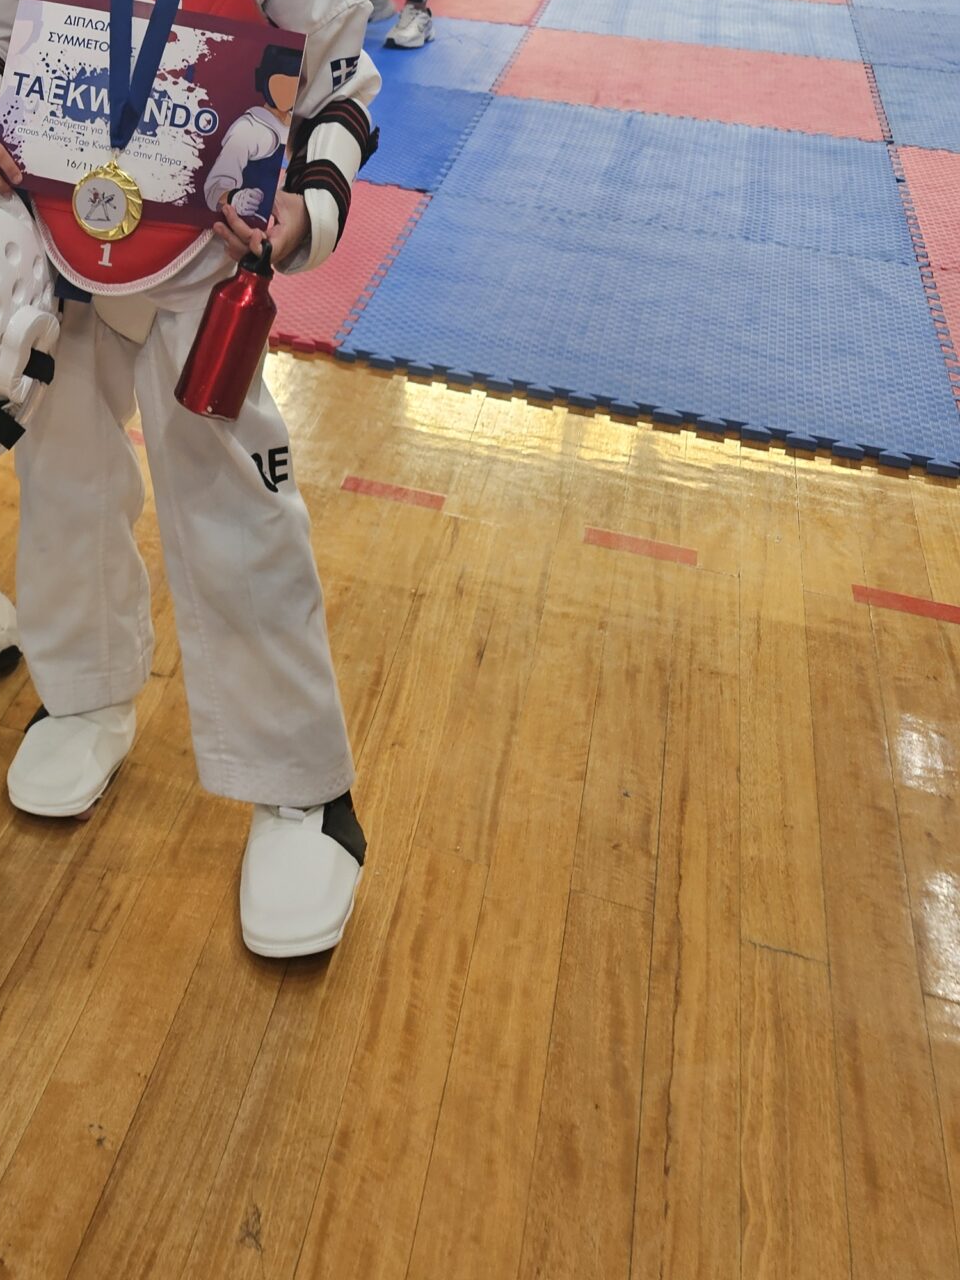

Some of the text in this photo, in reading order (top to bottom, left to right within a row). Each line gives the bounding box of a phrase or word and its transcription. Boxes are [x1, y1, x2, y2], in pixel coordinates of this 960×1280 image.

[64, 14, 110, 32] ΔΙΠΛΩ
[13, 71, 218, 135] TAEKWNDO
[92, 140, 111, 152] Kwo
[98, 242, 113, 267] 1
